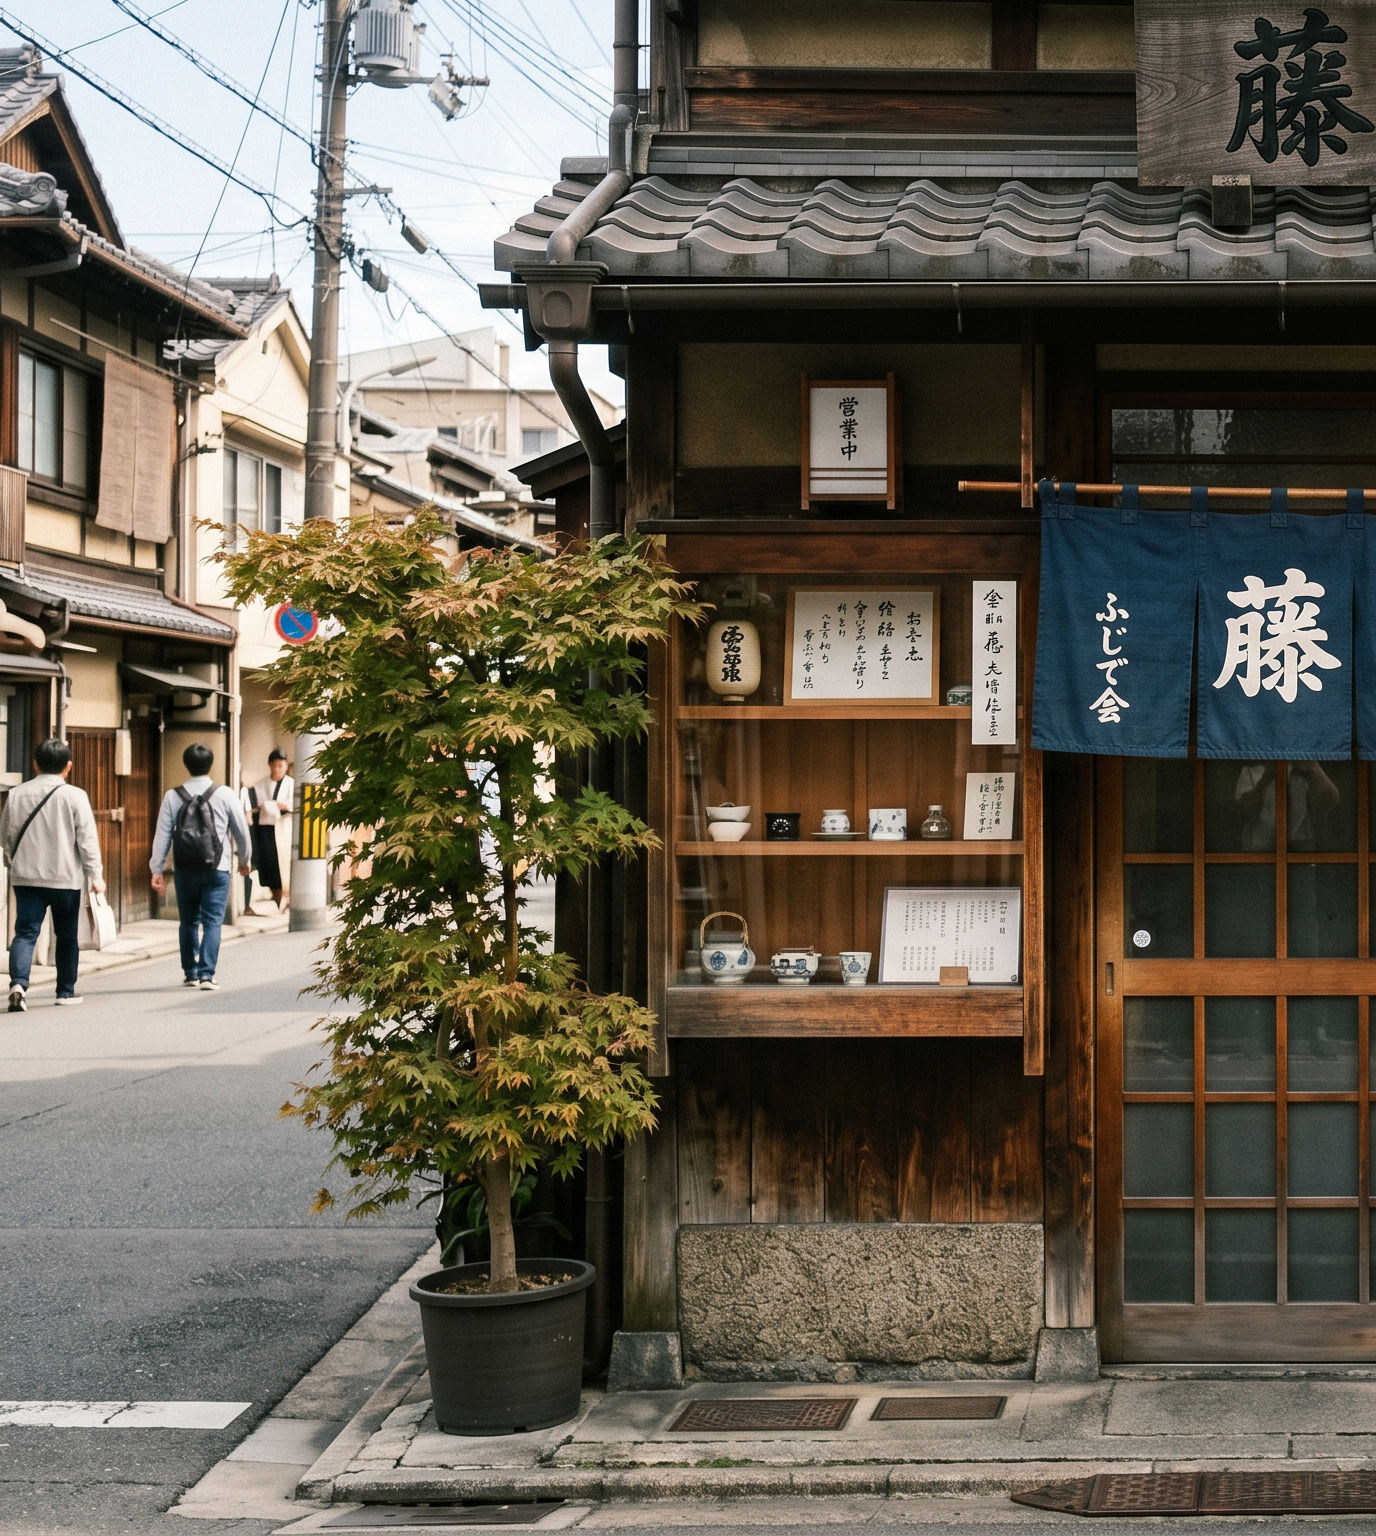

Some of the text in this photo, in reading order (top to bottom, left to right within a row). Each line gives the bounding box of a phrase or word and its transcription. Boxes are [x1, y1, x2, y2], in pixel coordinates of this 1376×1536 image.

[839, 396, 859, 461] 営業中
[1089, 592, 1130, 723] ふじで会
